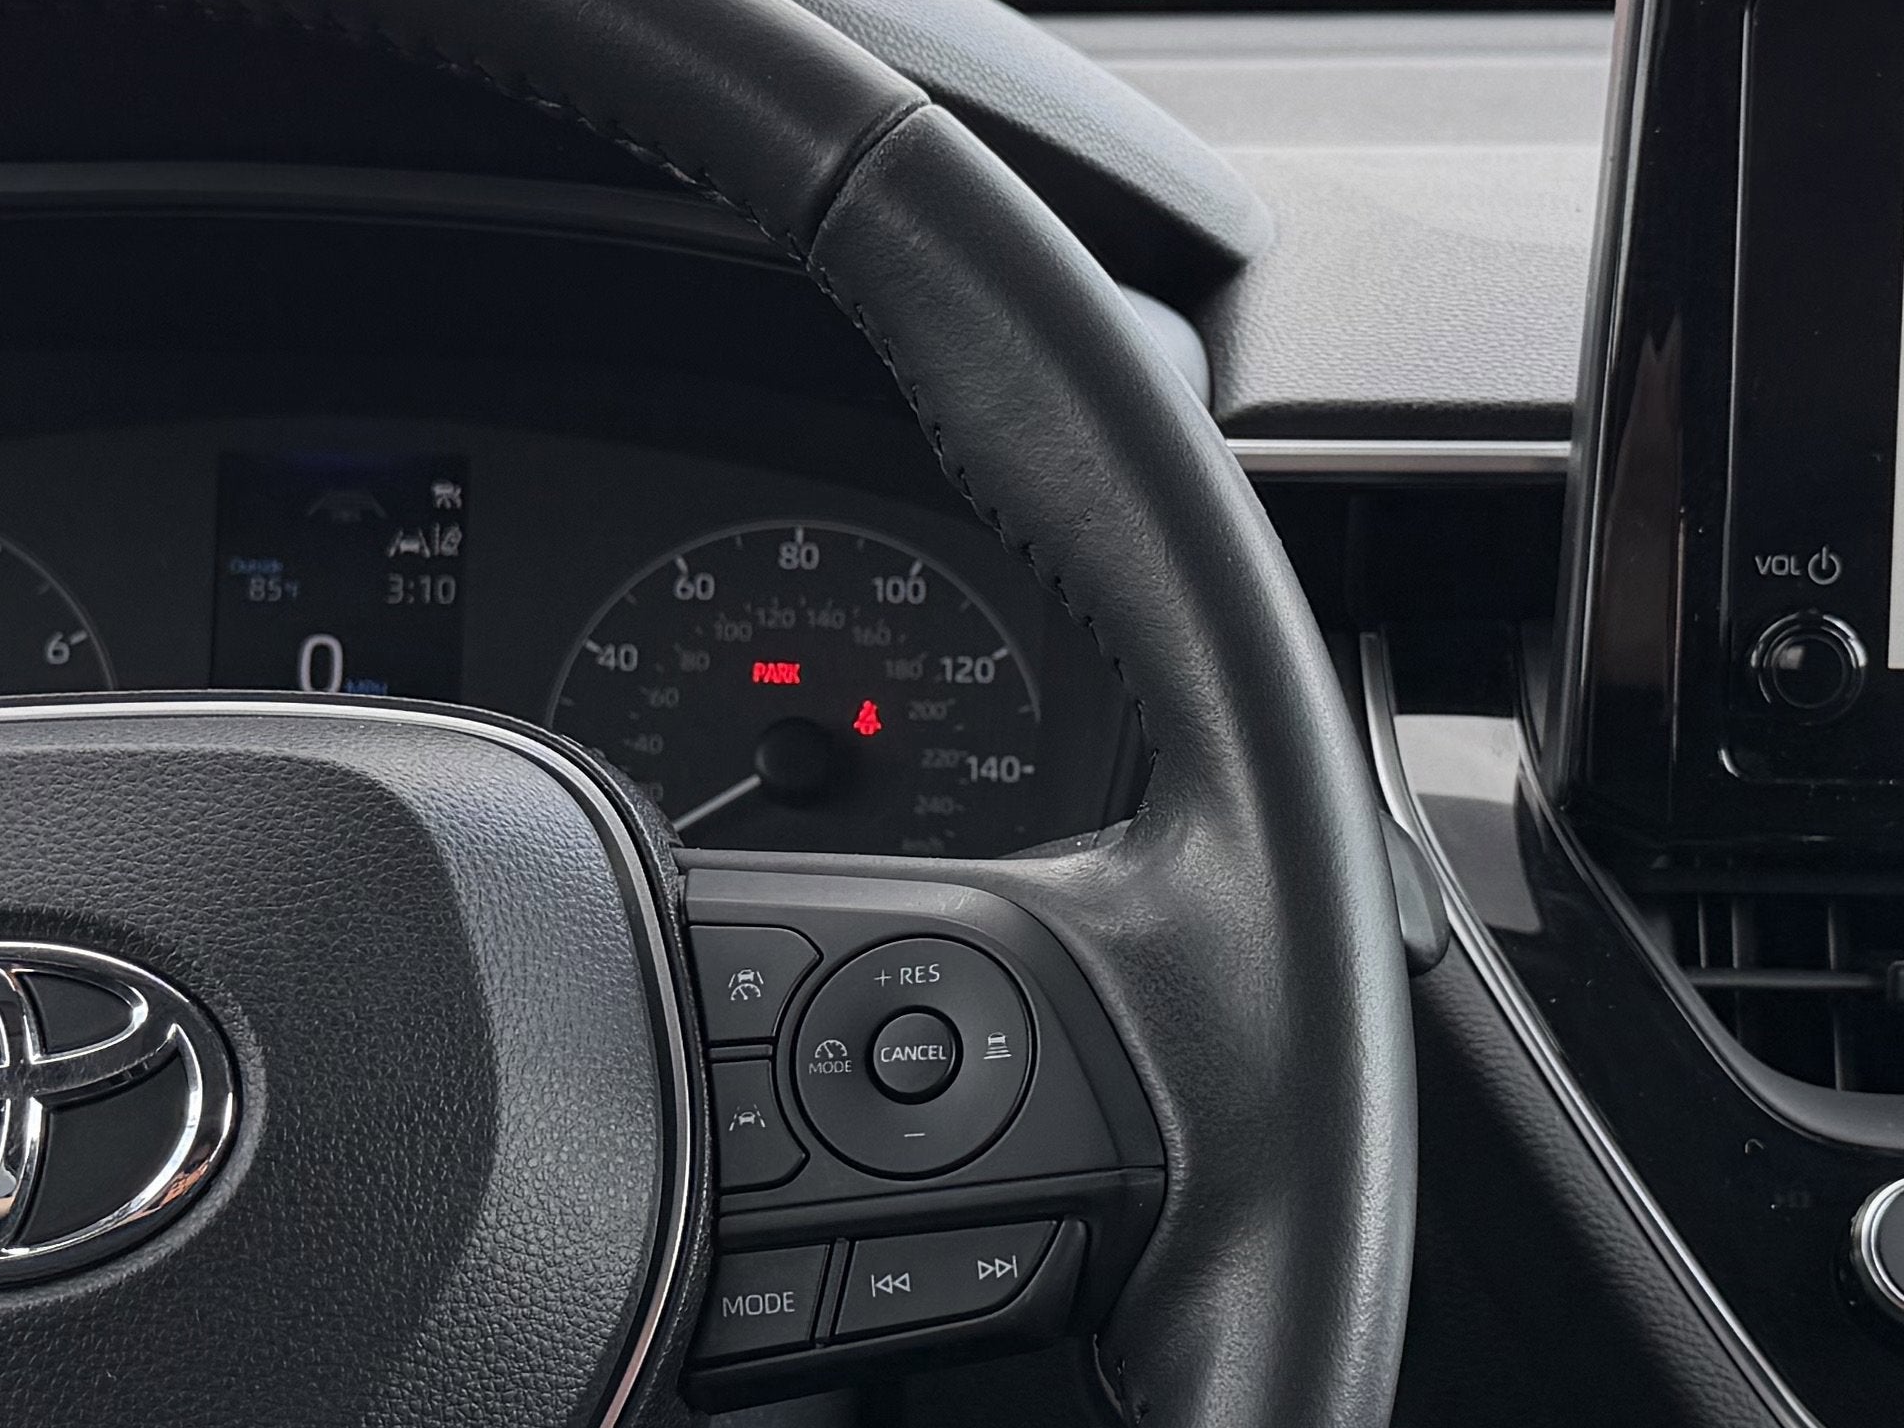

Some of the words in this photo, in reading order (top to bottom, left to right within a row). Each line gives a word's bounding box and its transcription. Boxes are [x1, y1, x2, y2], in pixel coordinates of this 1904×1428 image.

[777, 541, 820, 570] 80
[1754, 554, 1801, 577] VOL
[385, 573, 456, 604] 3:10
[672, 572, 716, 601] 60
[873, 573, 927, 605] 100
[756, 606, 796, 629] 120
[806, 607, 847, 630] 140
[714, 620, 753, 643] 100
[45, 631, 71, 665] 6
[599, 642, 638, 671] 40
[299, 633, 344, 692] 0
[751, 660, 802, 685] PARK
[940, 654, 995, 684] 120
[966, 754, 1021, 783] 140
[899, 964, 941, 985] RES
[880, 1045, 946, 1061] CANCEL
[808, 1060, 852, 1074] MODE
[722, 1291, 795, 1317] MODE
